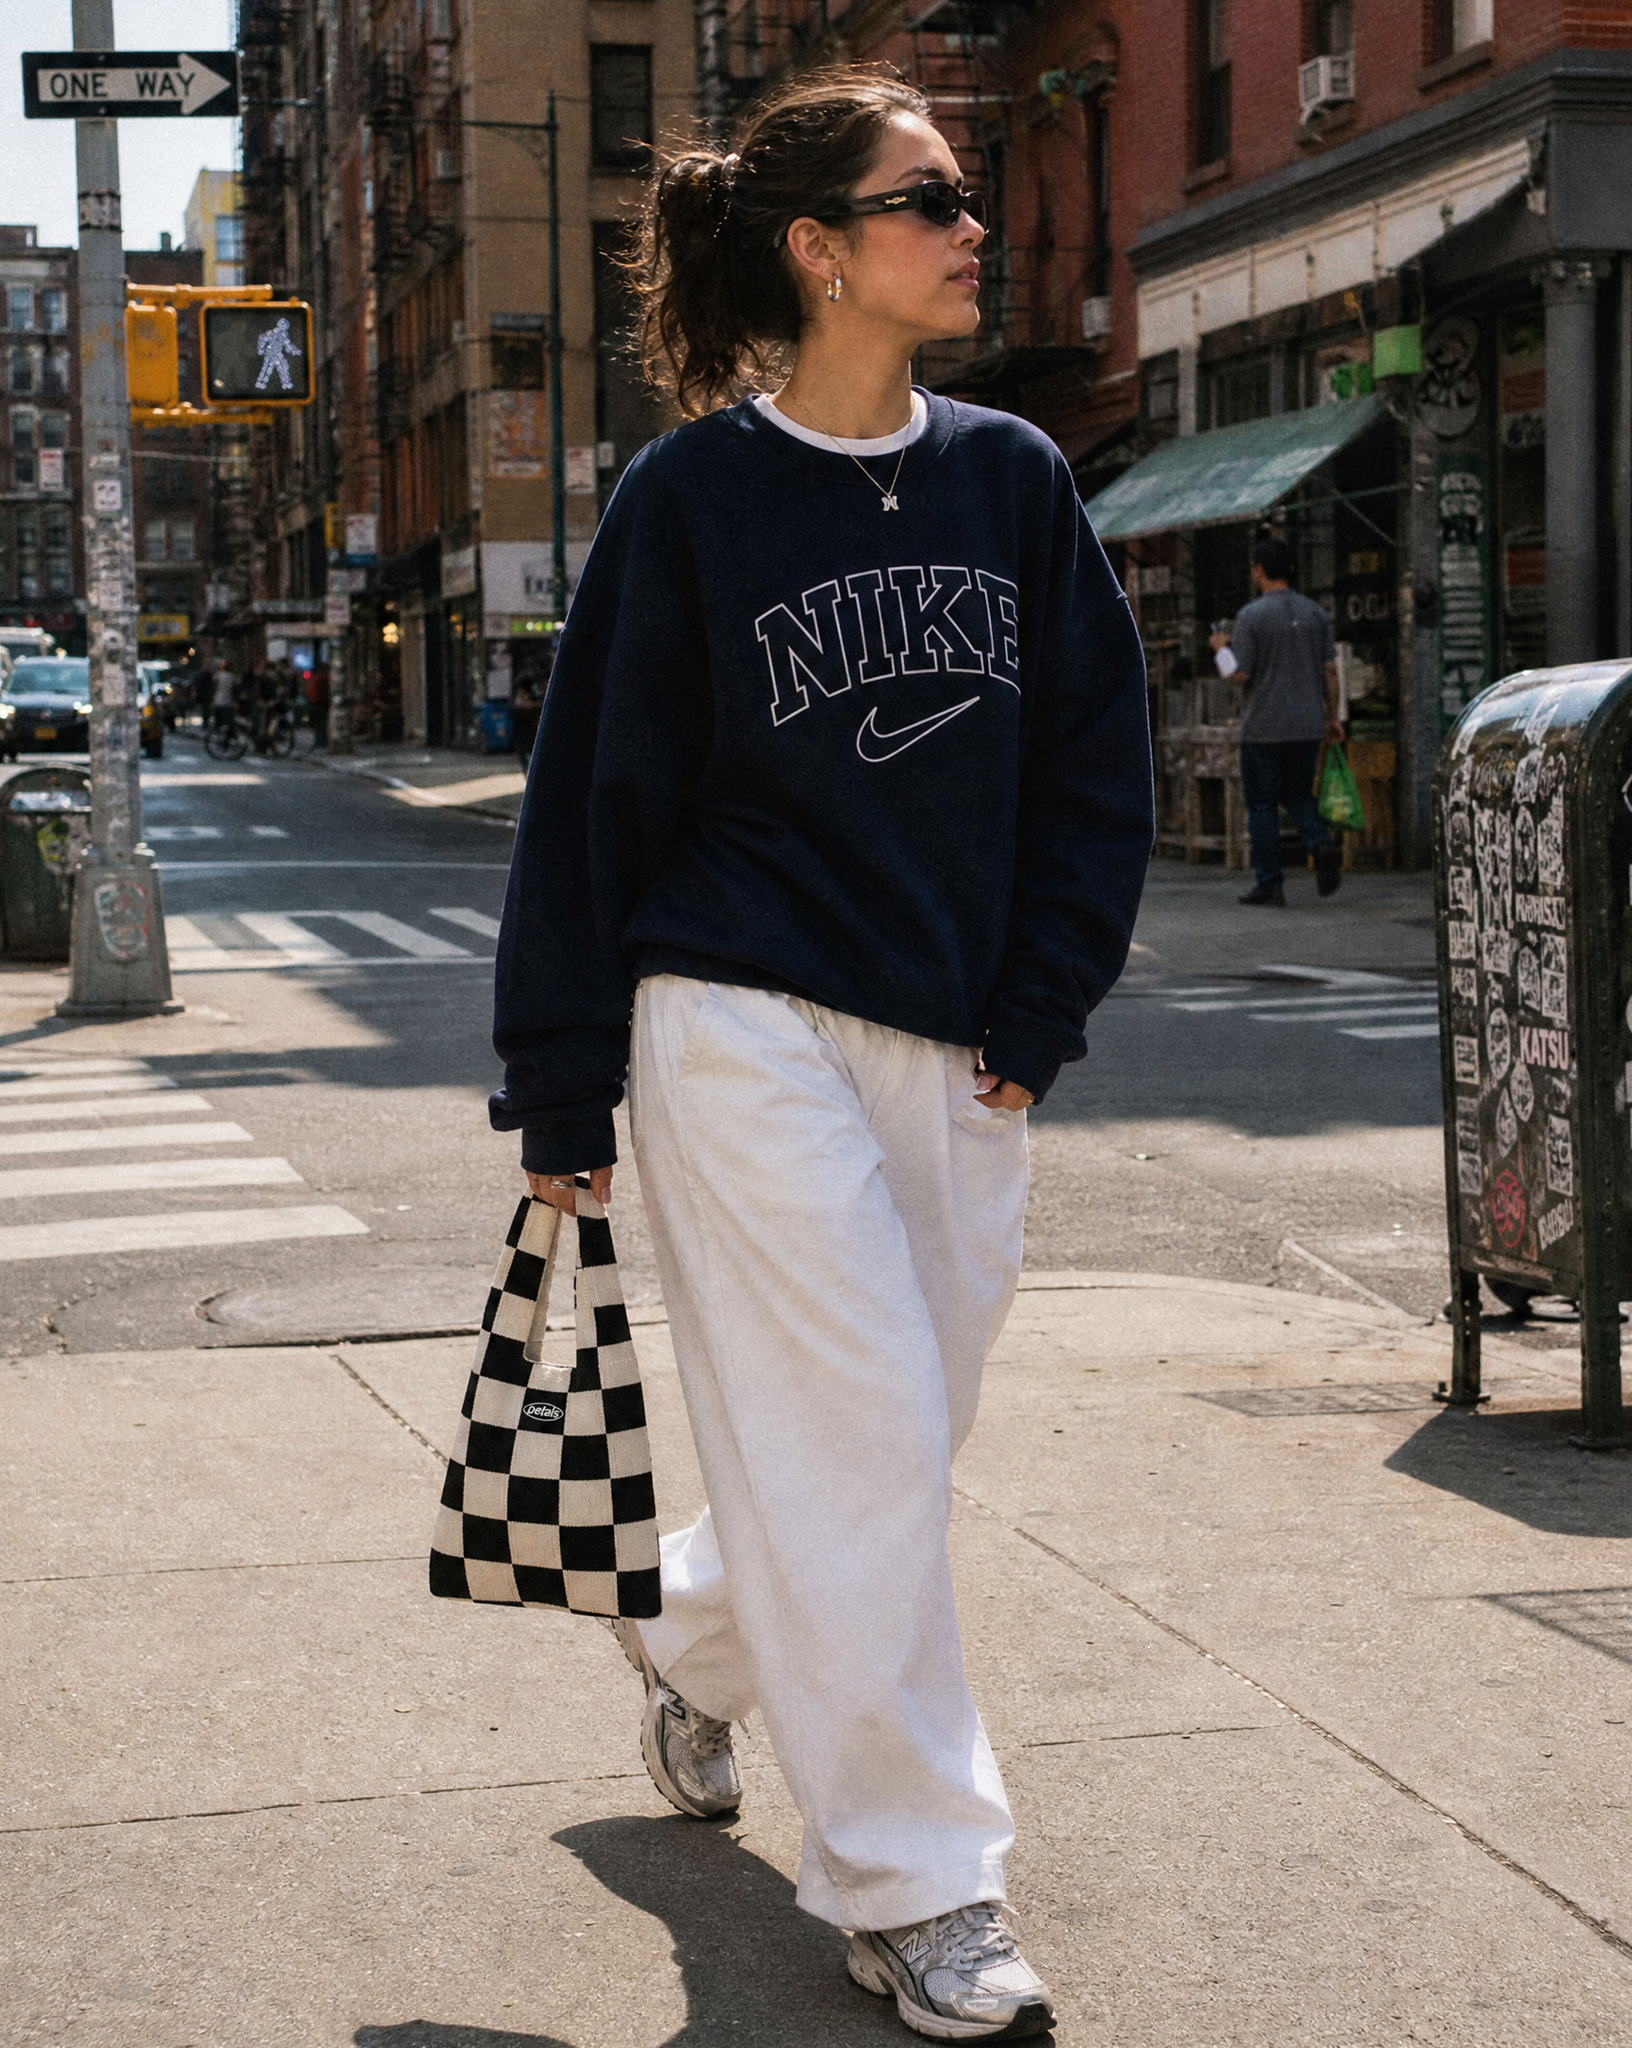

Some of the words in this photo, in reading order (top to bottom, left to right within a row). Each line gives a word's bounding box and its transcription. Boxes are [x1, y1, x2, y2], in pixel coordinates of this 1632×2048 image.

[50, 72, 109, 98] ONE
[135, 71, 196, 98] WAY
[754, 565, 1022, 727] NIKE
[1519, 1025, 1569, 1071] KATSU
